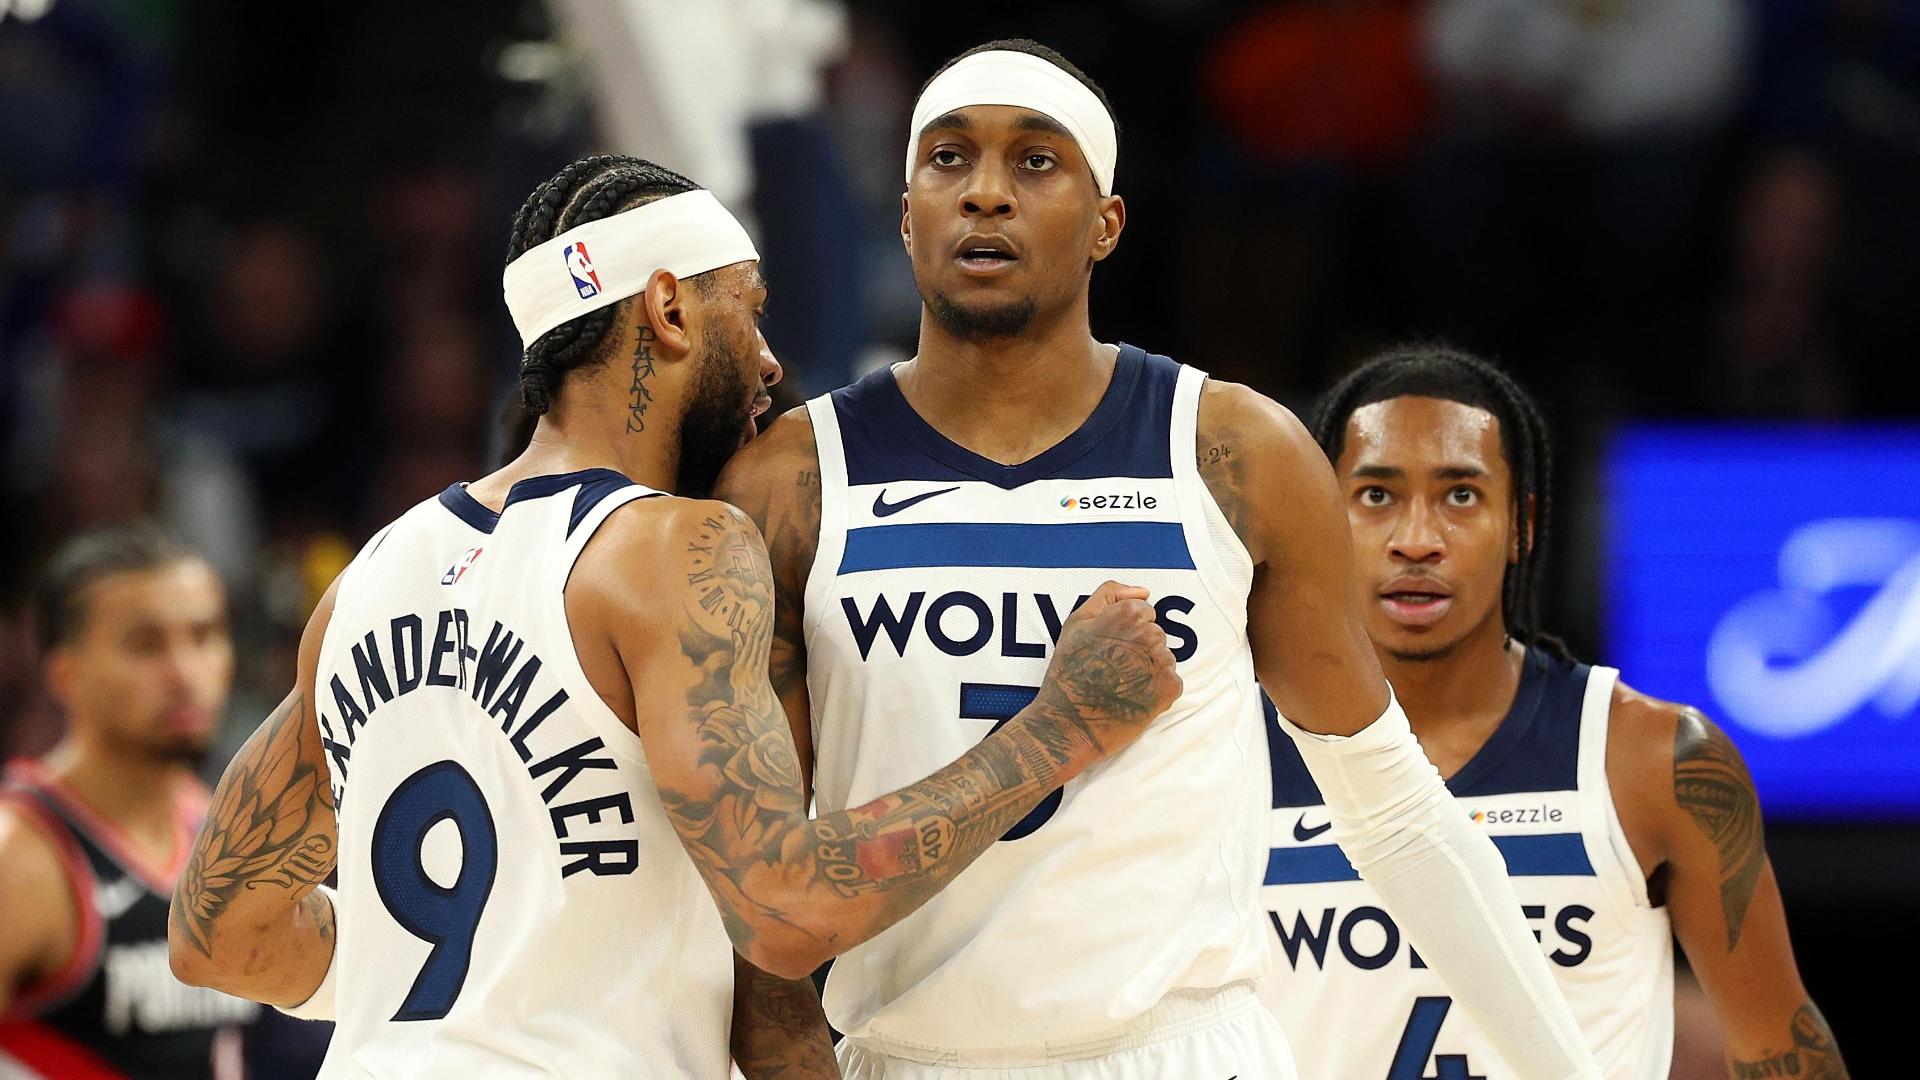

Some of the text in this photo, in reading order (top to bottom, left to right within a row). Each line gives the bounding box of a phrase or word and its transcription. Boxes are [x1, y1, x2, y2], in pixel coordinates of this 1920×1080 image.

[1079, 491, 1157, 509] sezzle
[841, 591, 1199, 662] WOLVS
[1486, 804, 1562, 823] sezzle
[371, 759, 497, 1022] 9
[1268, 904, 1595, 972] WOS
